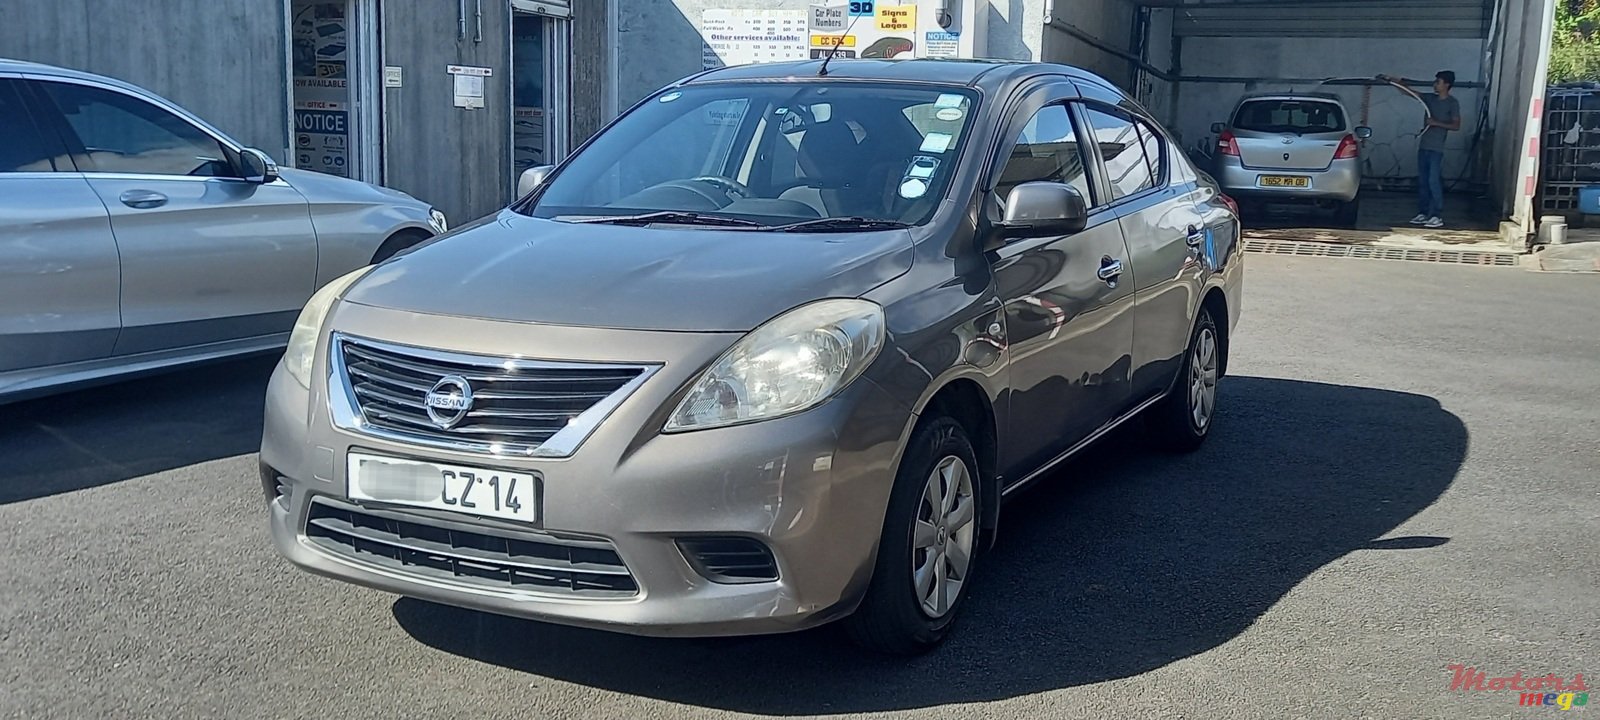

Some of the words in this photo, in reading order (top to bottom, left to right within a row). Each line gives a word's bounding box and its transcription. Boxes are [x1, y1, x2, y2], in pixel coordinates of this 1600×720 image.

[850, 1, 873, 13] 3D
[815, 8, 825, 17] Car
[826, 8, 842, 18] Plate
[881, 10, 908, 18] Signs
[815, 18, 842, 27] Numbers
[881, 22, 908, 30] Logos
[711, 34, 732, 42] Other
[734, 34, 763, 42] services
[927, 32, 957, 40] NOTICE
[308, 79, 347, 88] AVAILABLE
[295, 112, 345, 132] NOTICE
[428, 395, 465, 408] NISSAN
[441, 469, 476, 508] CZ
[488, 475, 522, 514] 14
